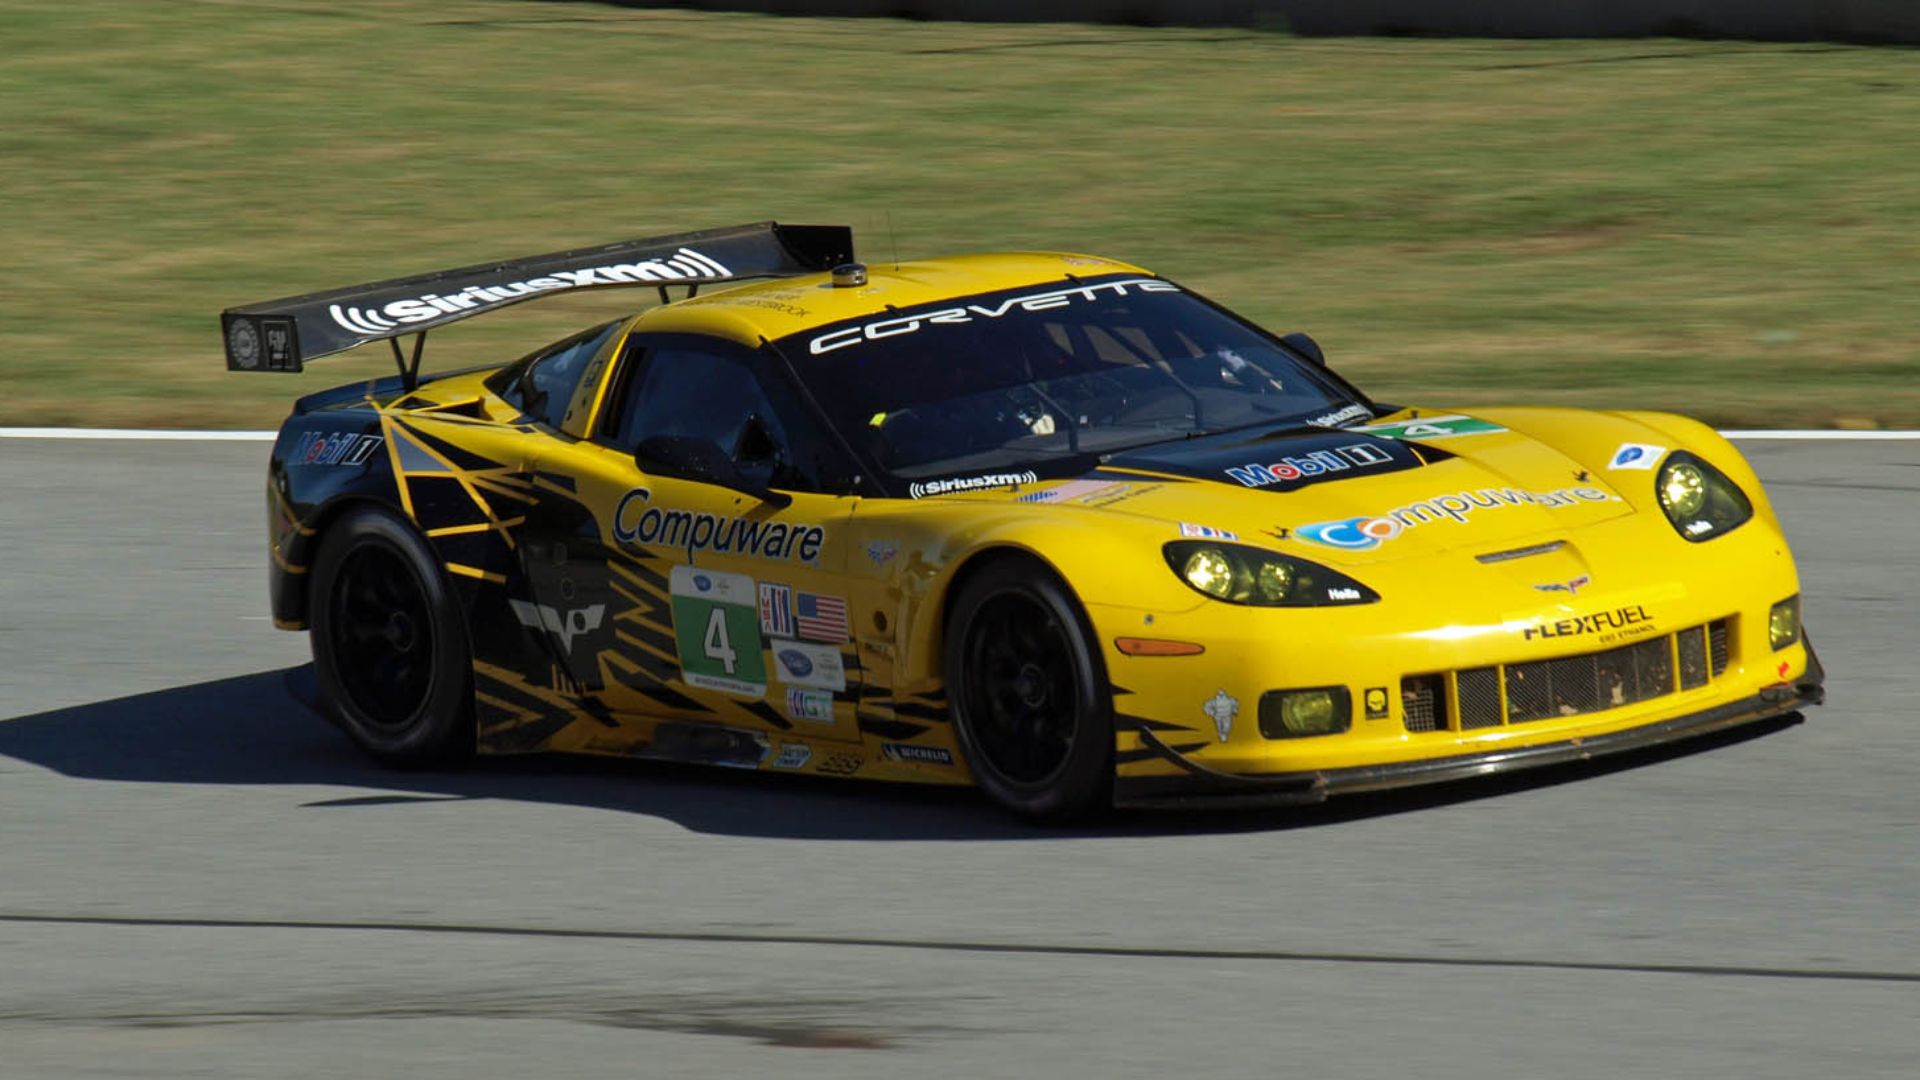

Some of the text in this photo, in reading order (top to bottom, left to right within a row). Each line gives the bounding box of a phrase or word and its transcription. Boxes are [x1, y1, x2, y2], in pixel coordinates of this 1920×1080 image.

[809, 279, 1182, 355] CORVETTE
[298, 431, 360, 465] Mobil
[1404, 424, 1454, 436] 4
[1224, 450, 1350, 487] Mobil
[612, 488, 824, 566] Compuware
[1318, 486, 1607, 549] Compuware
[704, 607, 737, 674] 4
[900, 746, 950, 762] MICHELIN
